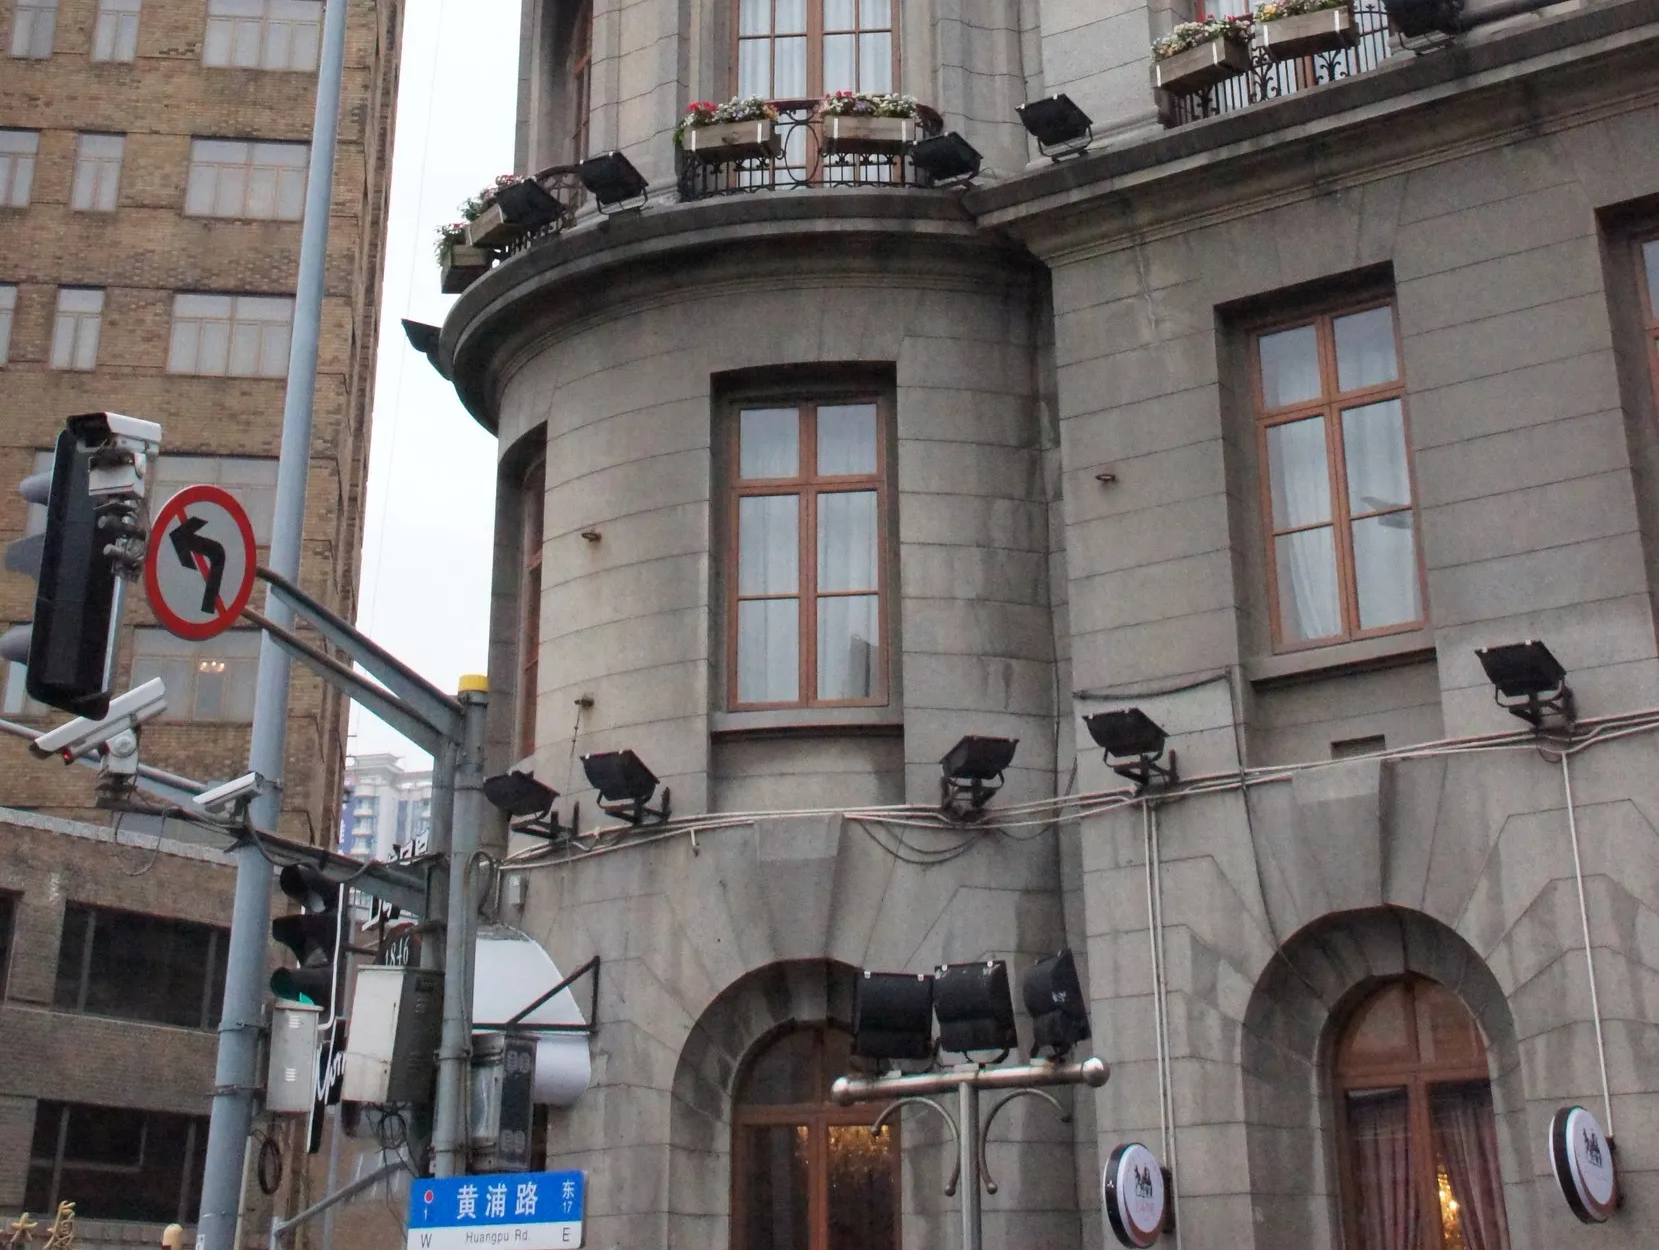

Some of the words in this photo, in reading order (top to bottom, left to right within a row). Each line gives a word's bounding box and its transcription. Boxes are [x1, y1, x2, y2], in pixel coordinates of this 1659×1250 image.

[562, 1180, 575, 1199] 东
[457, 1181, 538, 1219] 黄浦路
[562, 1201, 573, 1214] 17
[420, 1233, 433, 1248] W
[465, 1231, 510, 1246] Huangpu
[515, 1229, 531, 1242] Rd.
[562, 1227, 571, 1242] E
